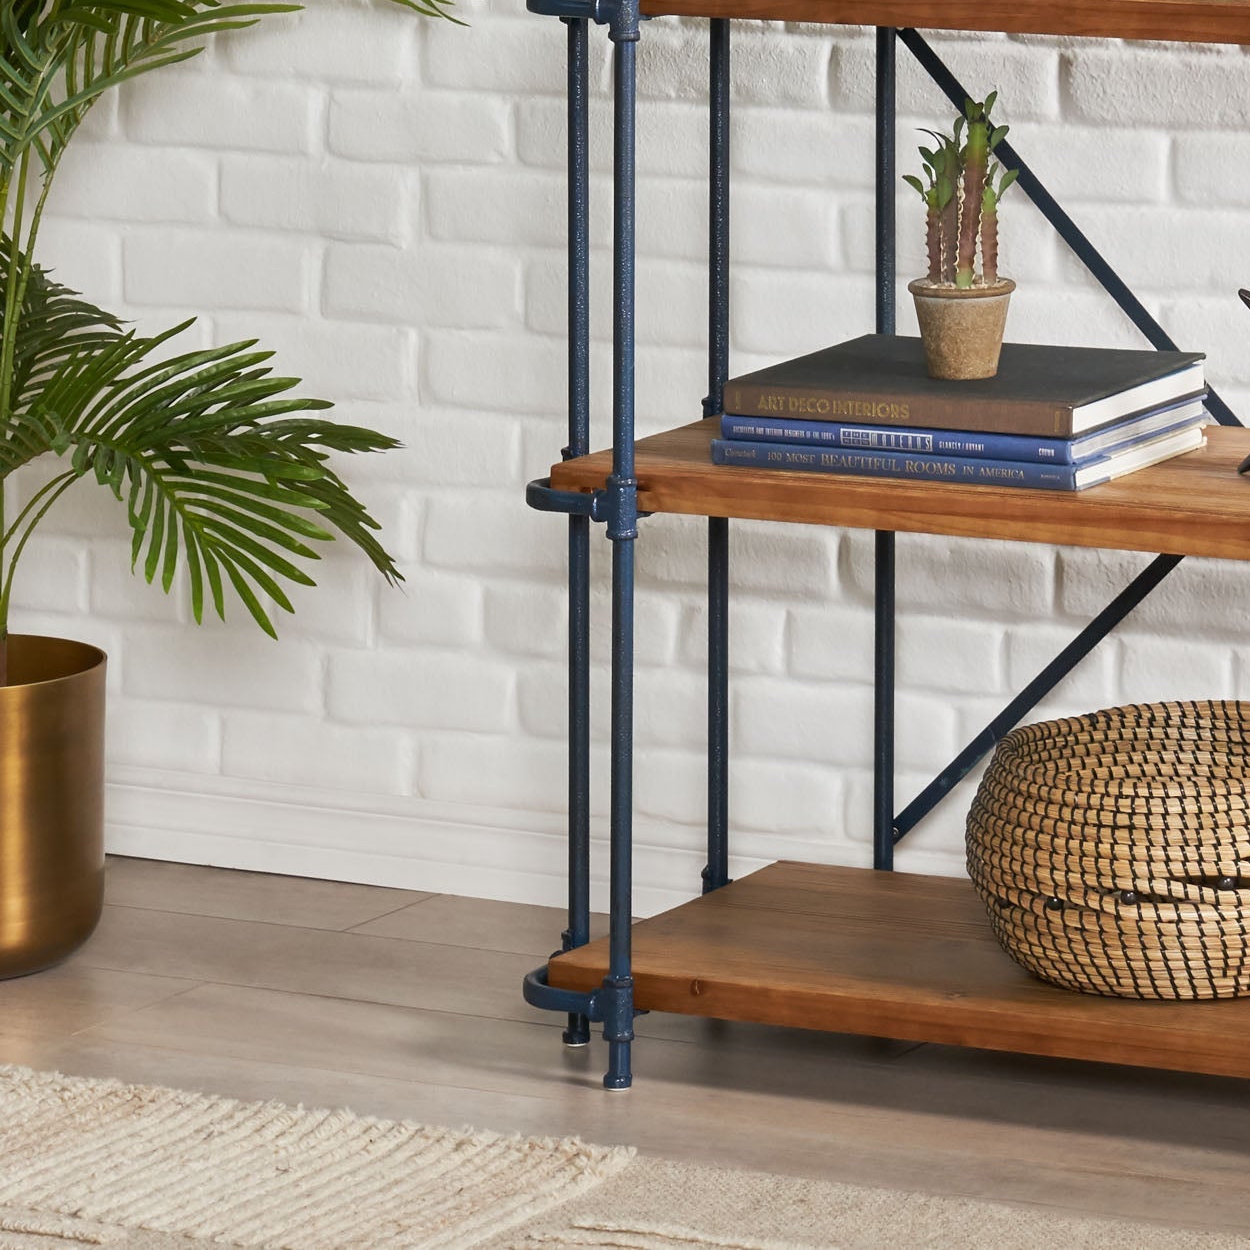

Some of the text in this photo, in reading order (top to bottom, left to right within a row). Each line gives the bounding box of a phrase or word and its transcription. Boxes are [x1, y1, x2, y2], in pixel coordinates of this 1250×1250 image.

[757, 395, 910, 420] ART DECO INTERIORS
[871, 433, 930, 450] MODERNS
[767, 452, 1025, 479] 100 MOST BEAUTIFUL ROOMS IN AMERICA
